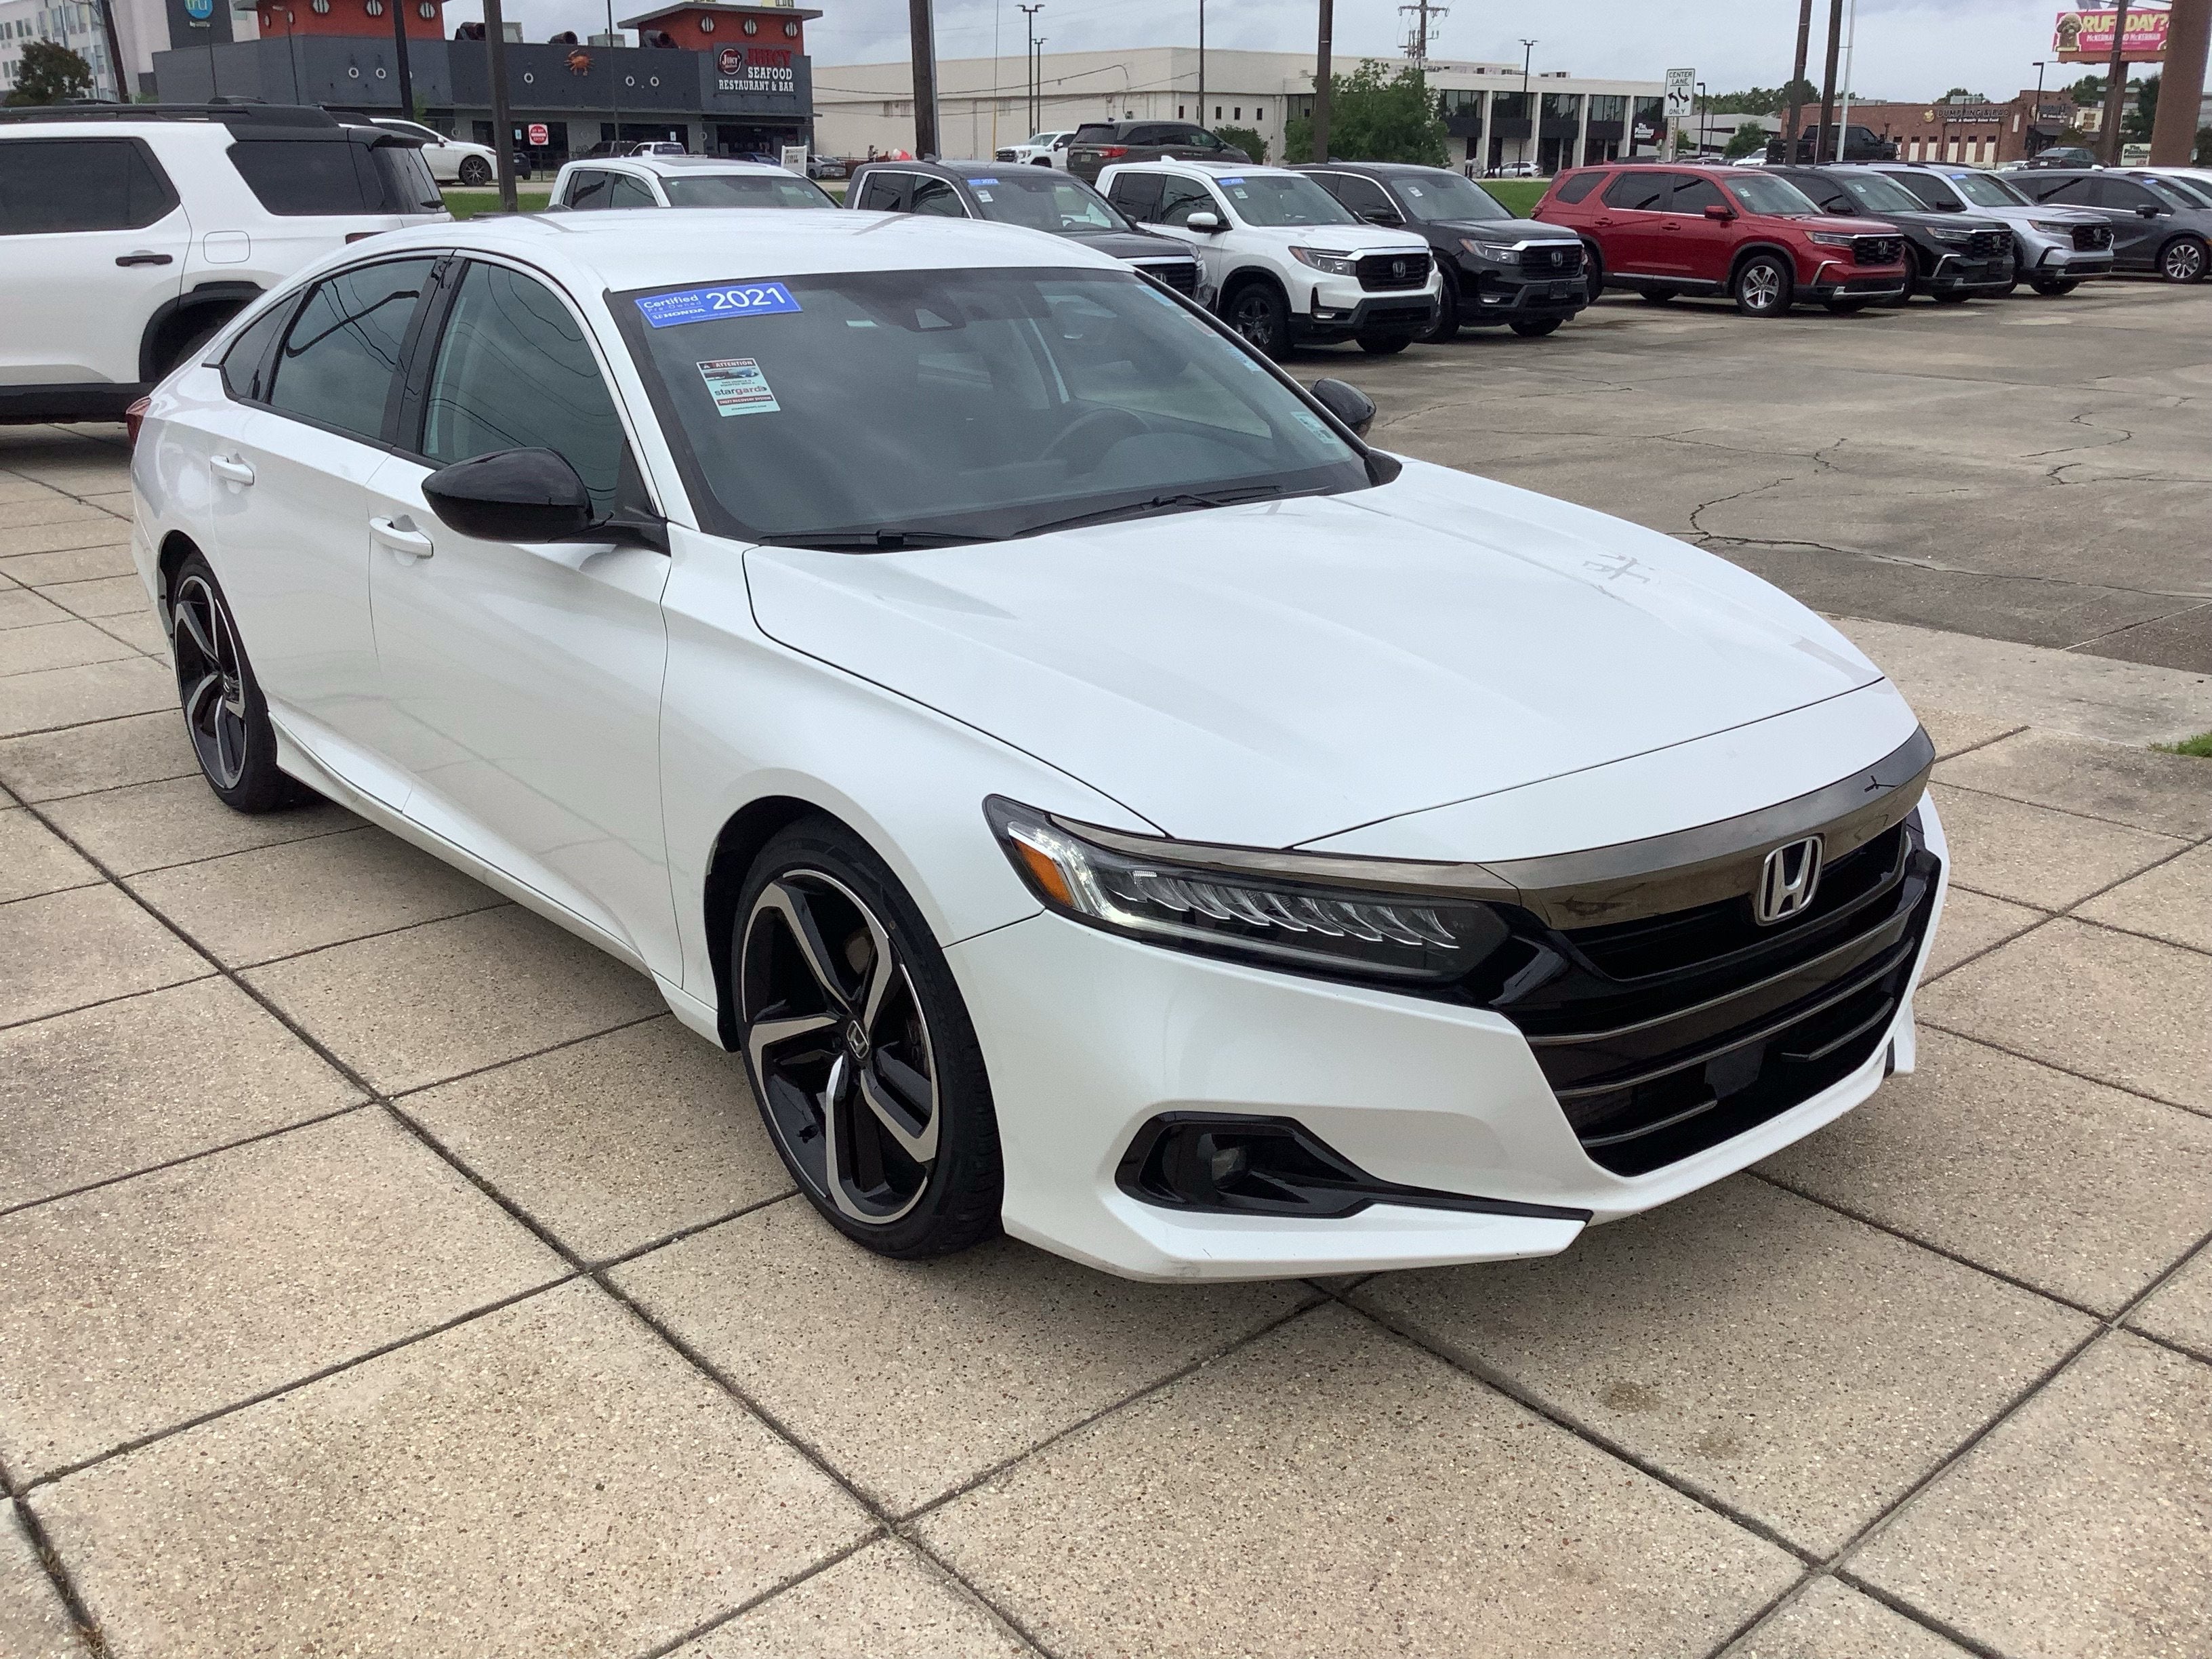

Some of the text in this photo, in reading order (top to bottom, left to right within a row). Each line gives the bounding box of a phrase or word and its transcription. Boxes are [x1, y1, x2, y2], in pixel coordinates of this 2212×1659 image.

[2082, 15, 2116, 33] RUF
[745, 48, 792, 66] JUICY
[747, 66, 792, 80] SEAFOOD
[718, 79, 794, 91] RESTAURANT & BAR
[643, 294, 699, 308] Certified
[705, 287, 785, 310] 2021
[668, 301, 702, 310] Owned
[663, 308, 707, 318] HONDA
[715, 360, 754, 368] ATTENTION
[714, 386, 767, 396] stargard
